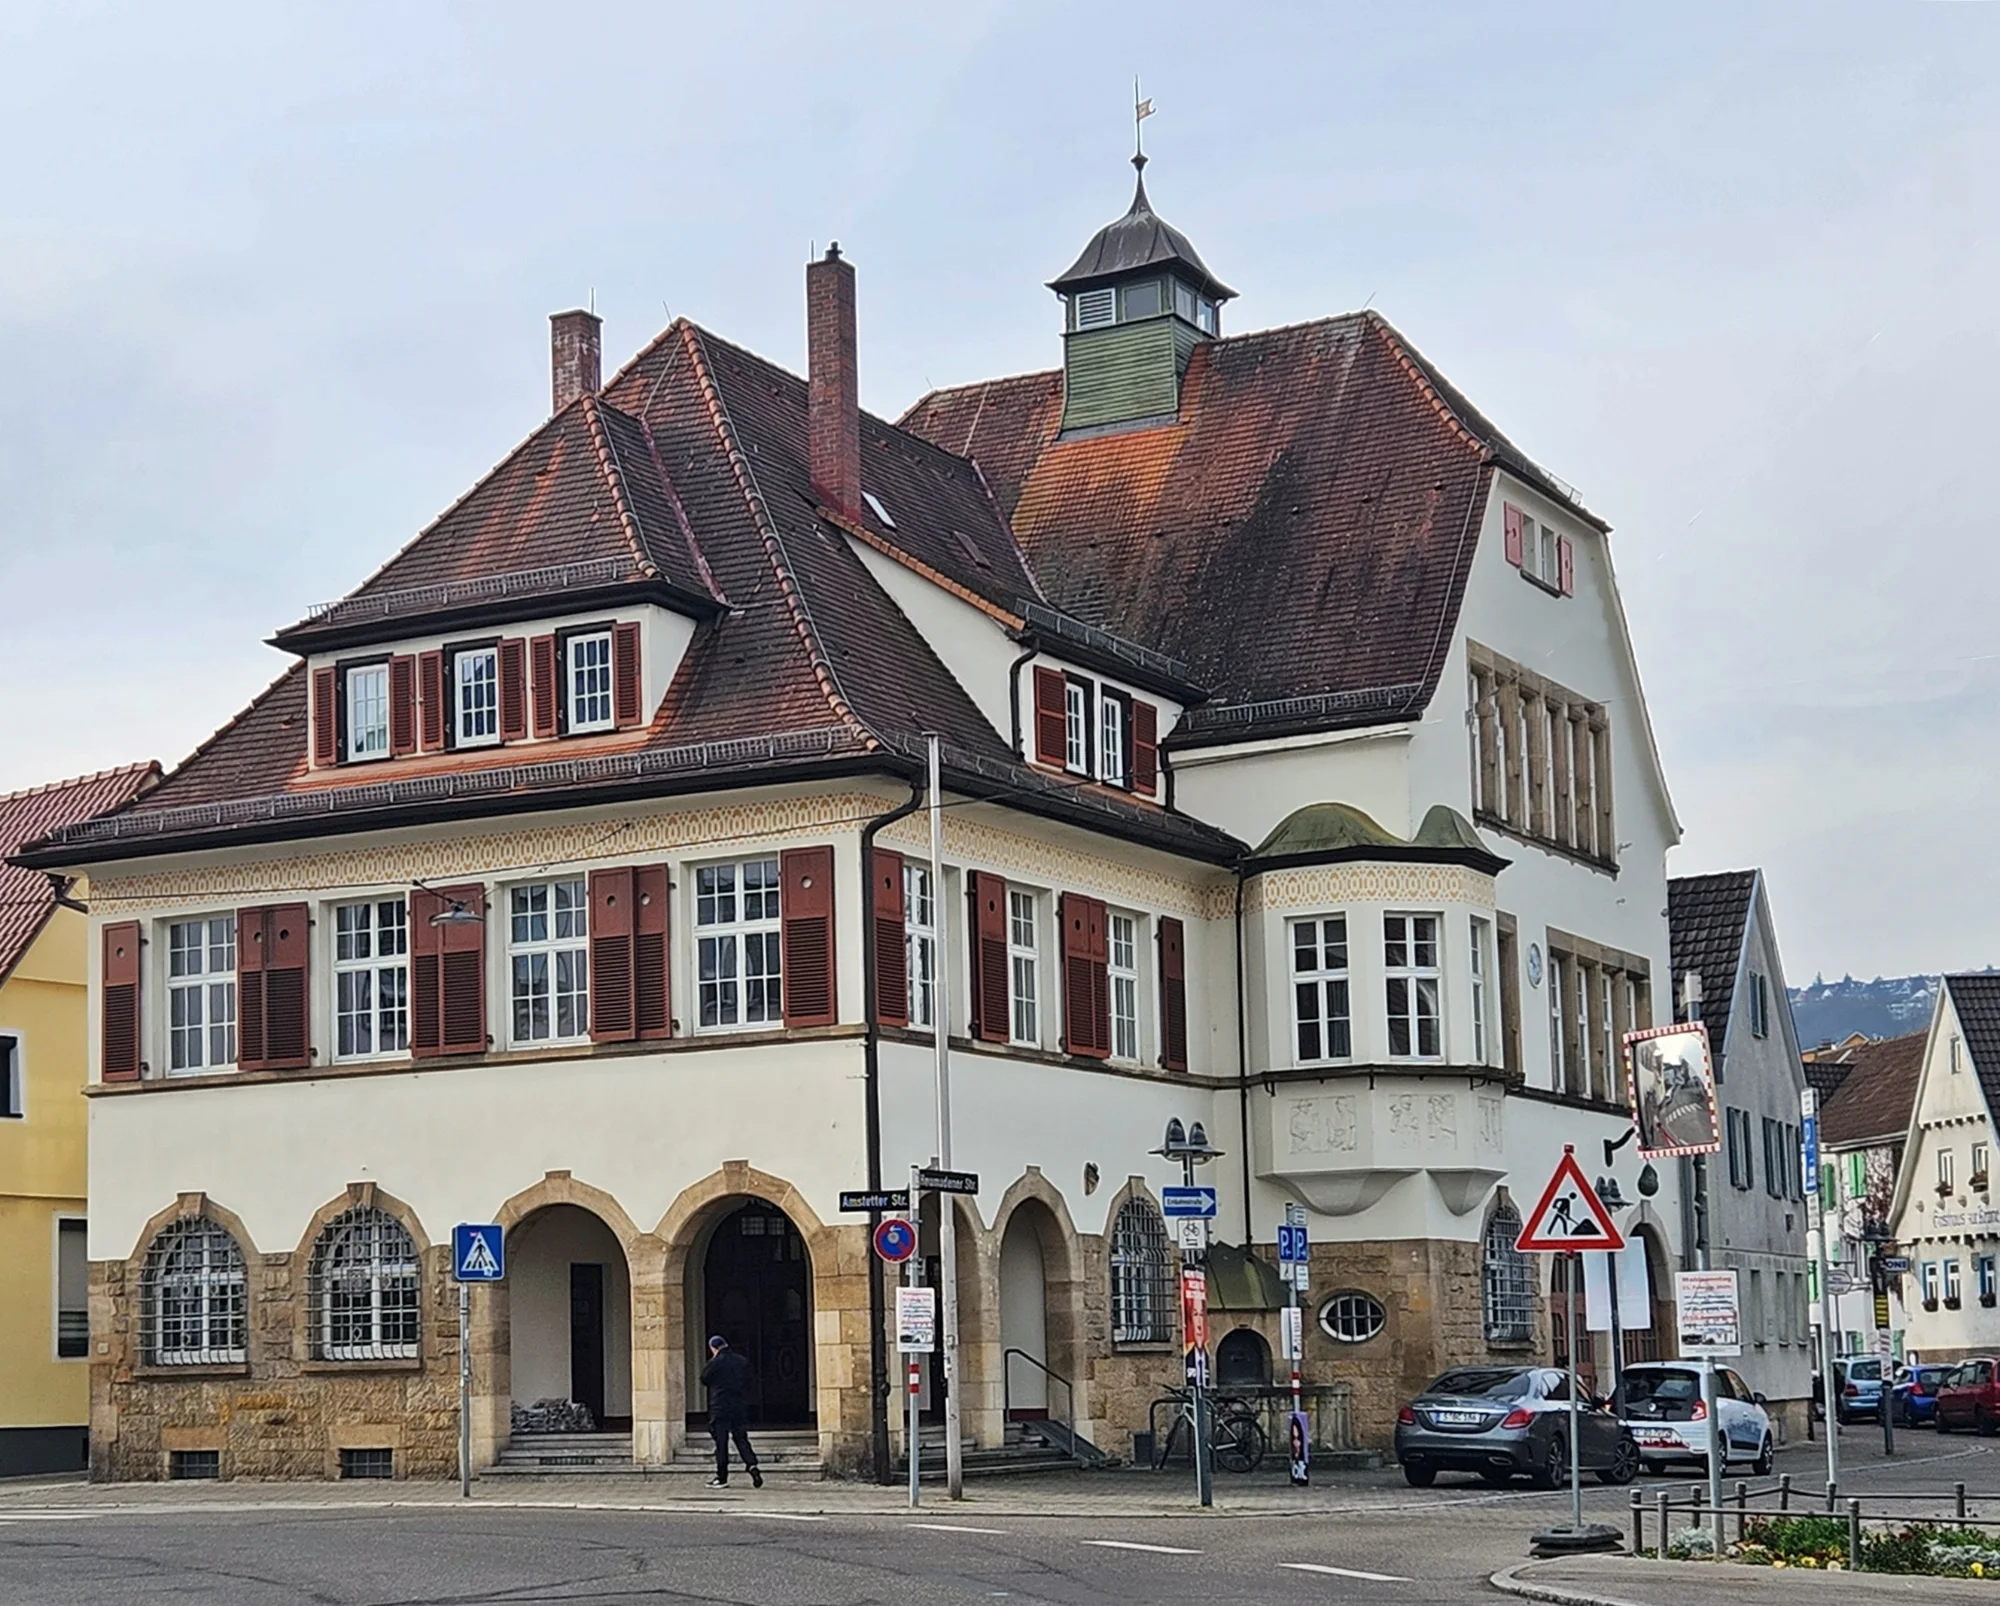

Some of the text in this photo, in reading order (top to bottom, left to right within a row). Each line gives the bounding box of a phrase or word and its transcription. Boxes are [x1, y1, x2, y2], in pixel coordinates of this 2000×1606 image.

[842, 1193, 908, 1208] Amstetter Str.
[1281, 1230, 1289, 1257] P
[1296, 1231, 1304, 1258] P
